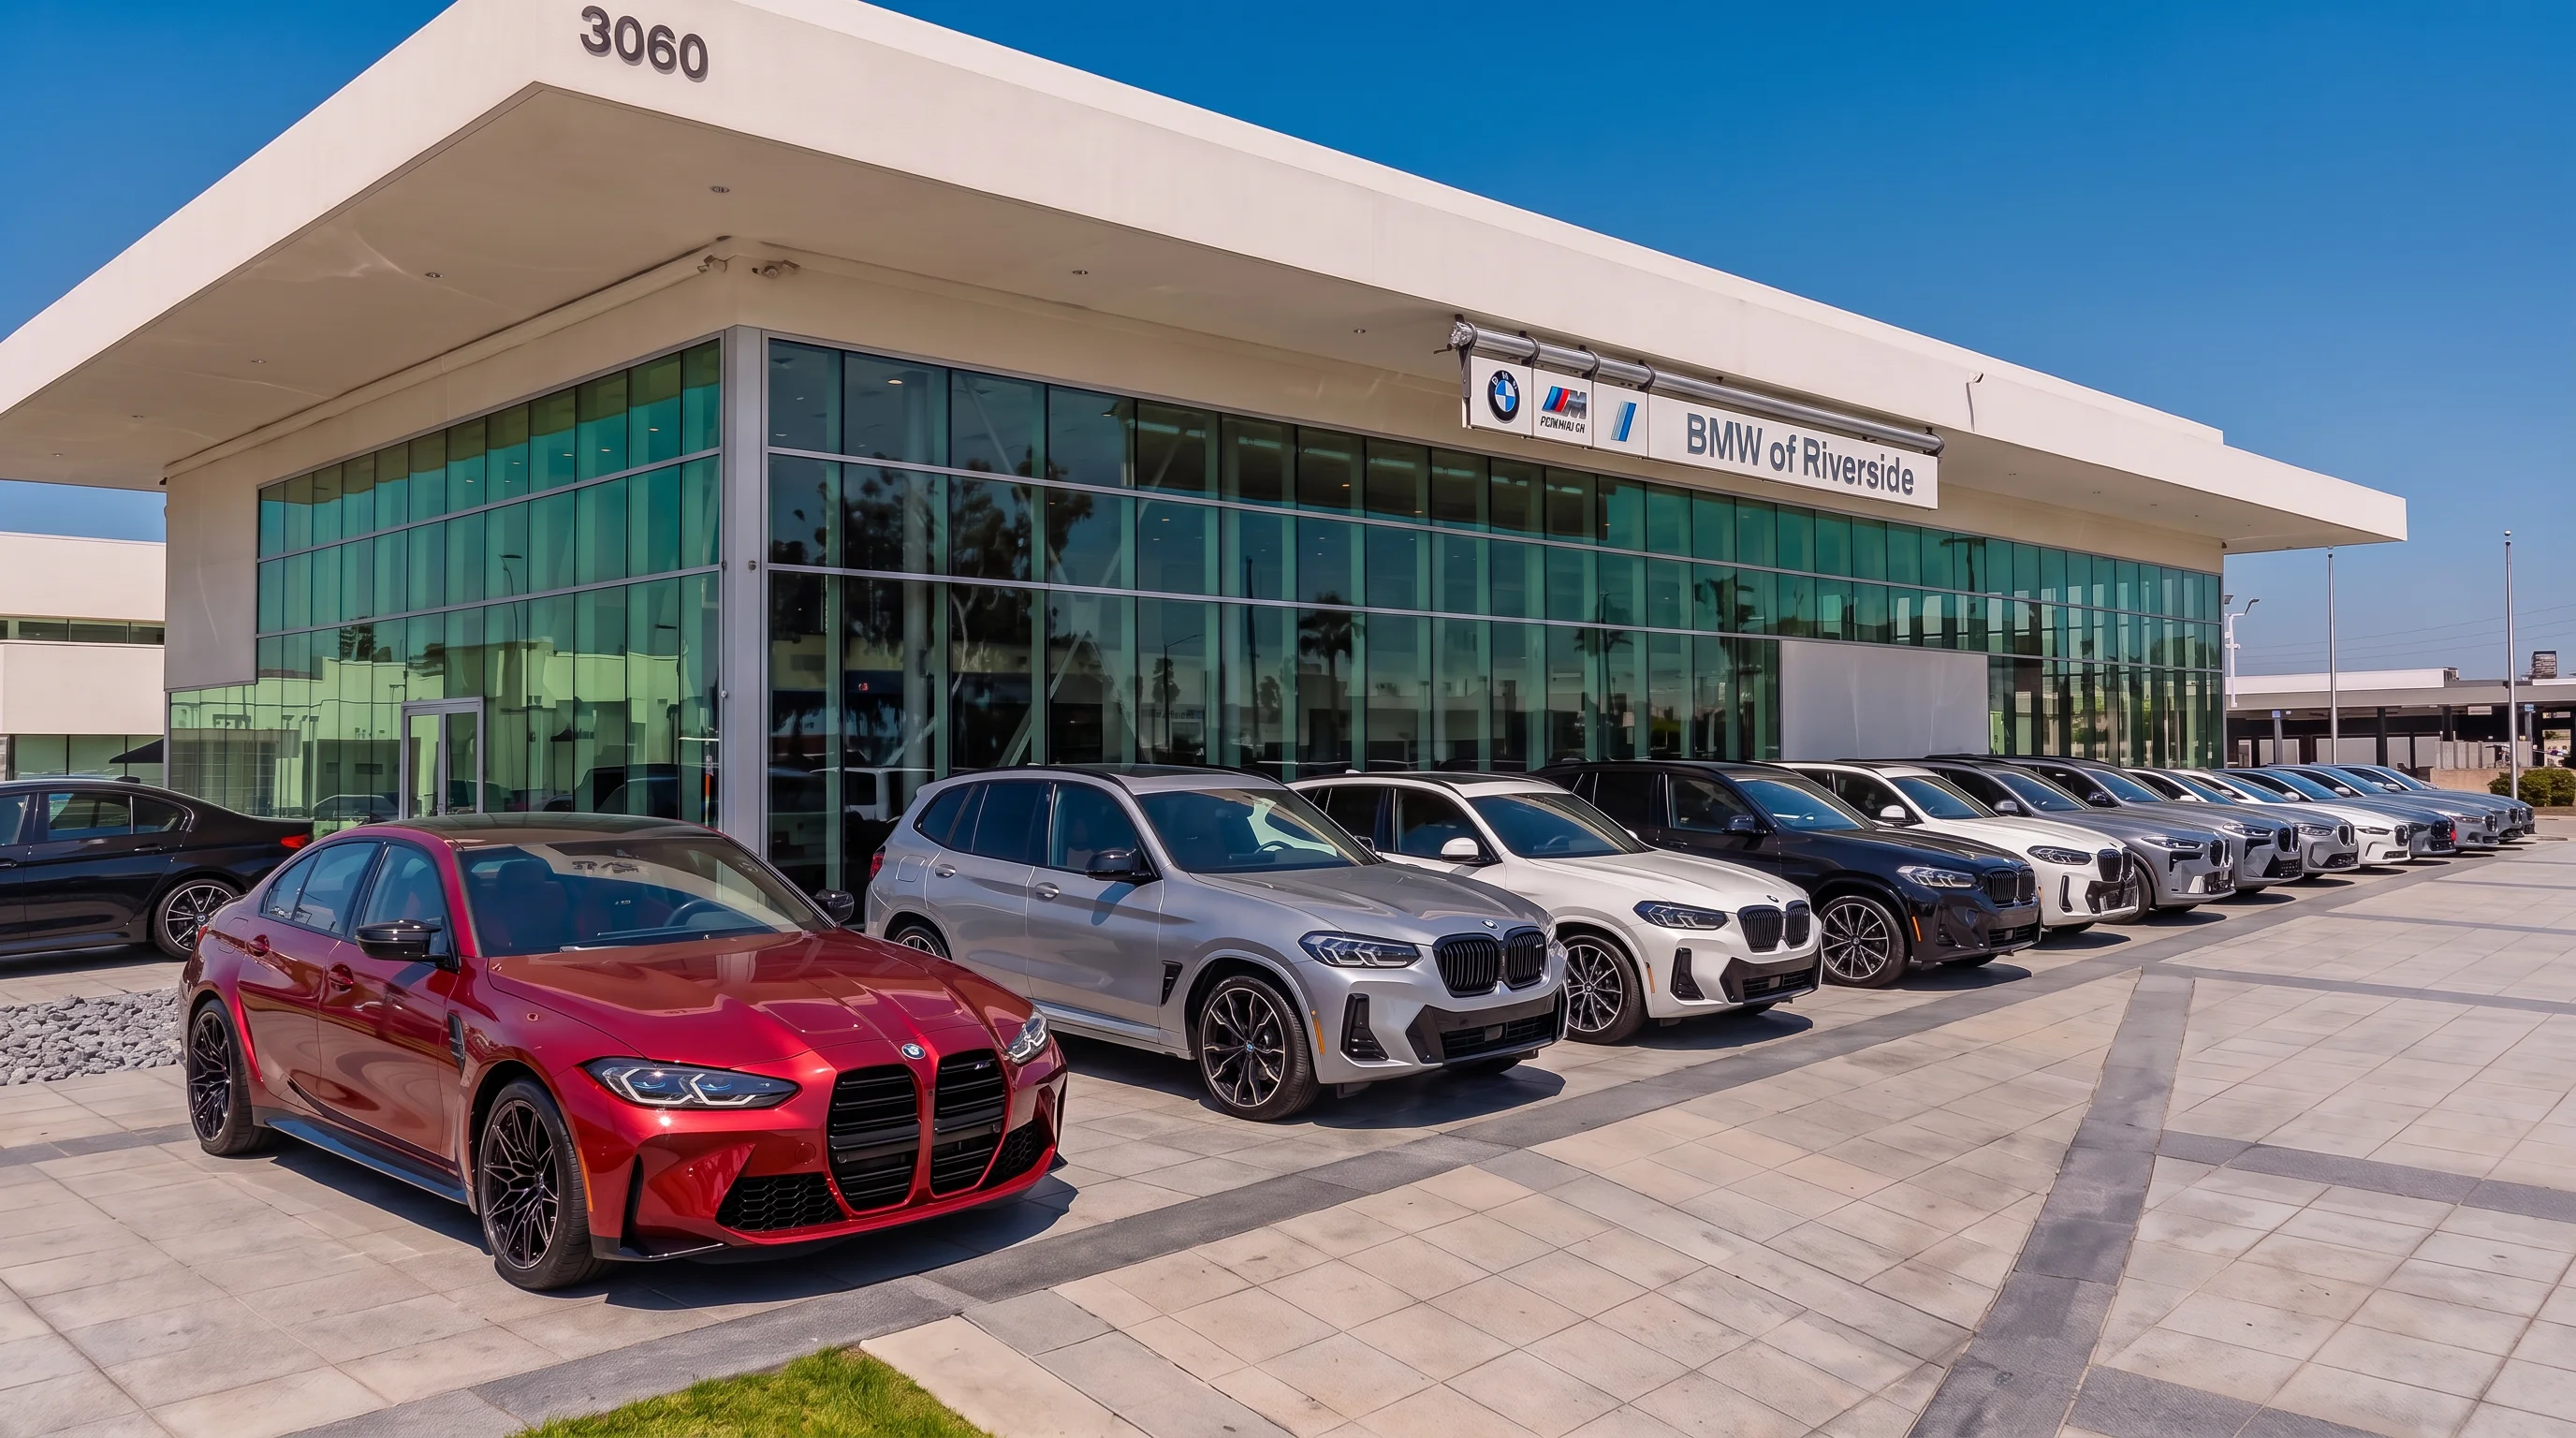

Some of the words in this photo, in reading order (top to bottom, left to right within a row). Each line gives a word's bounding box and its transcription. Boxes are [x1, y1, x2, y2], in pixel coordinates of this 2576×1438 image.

[579, 6, 709, 81] 3060
[1688, 412, 1763, 466] BMW
[1770, 434, 1797, 473] of
[1804, 437, 1914, 495] Riverside
